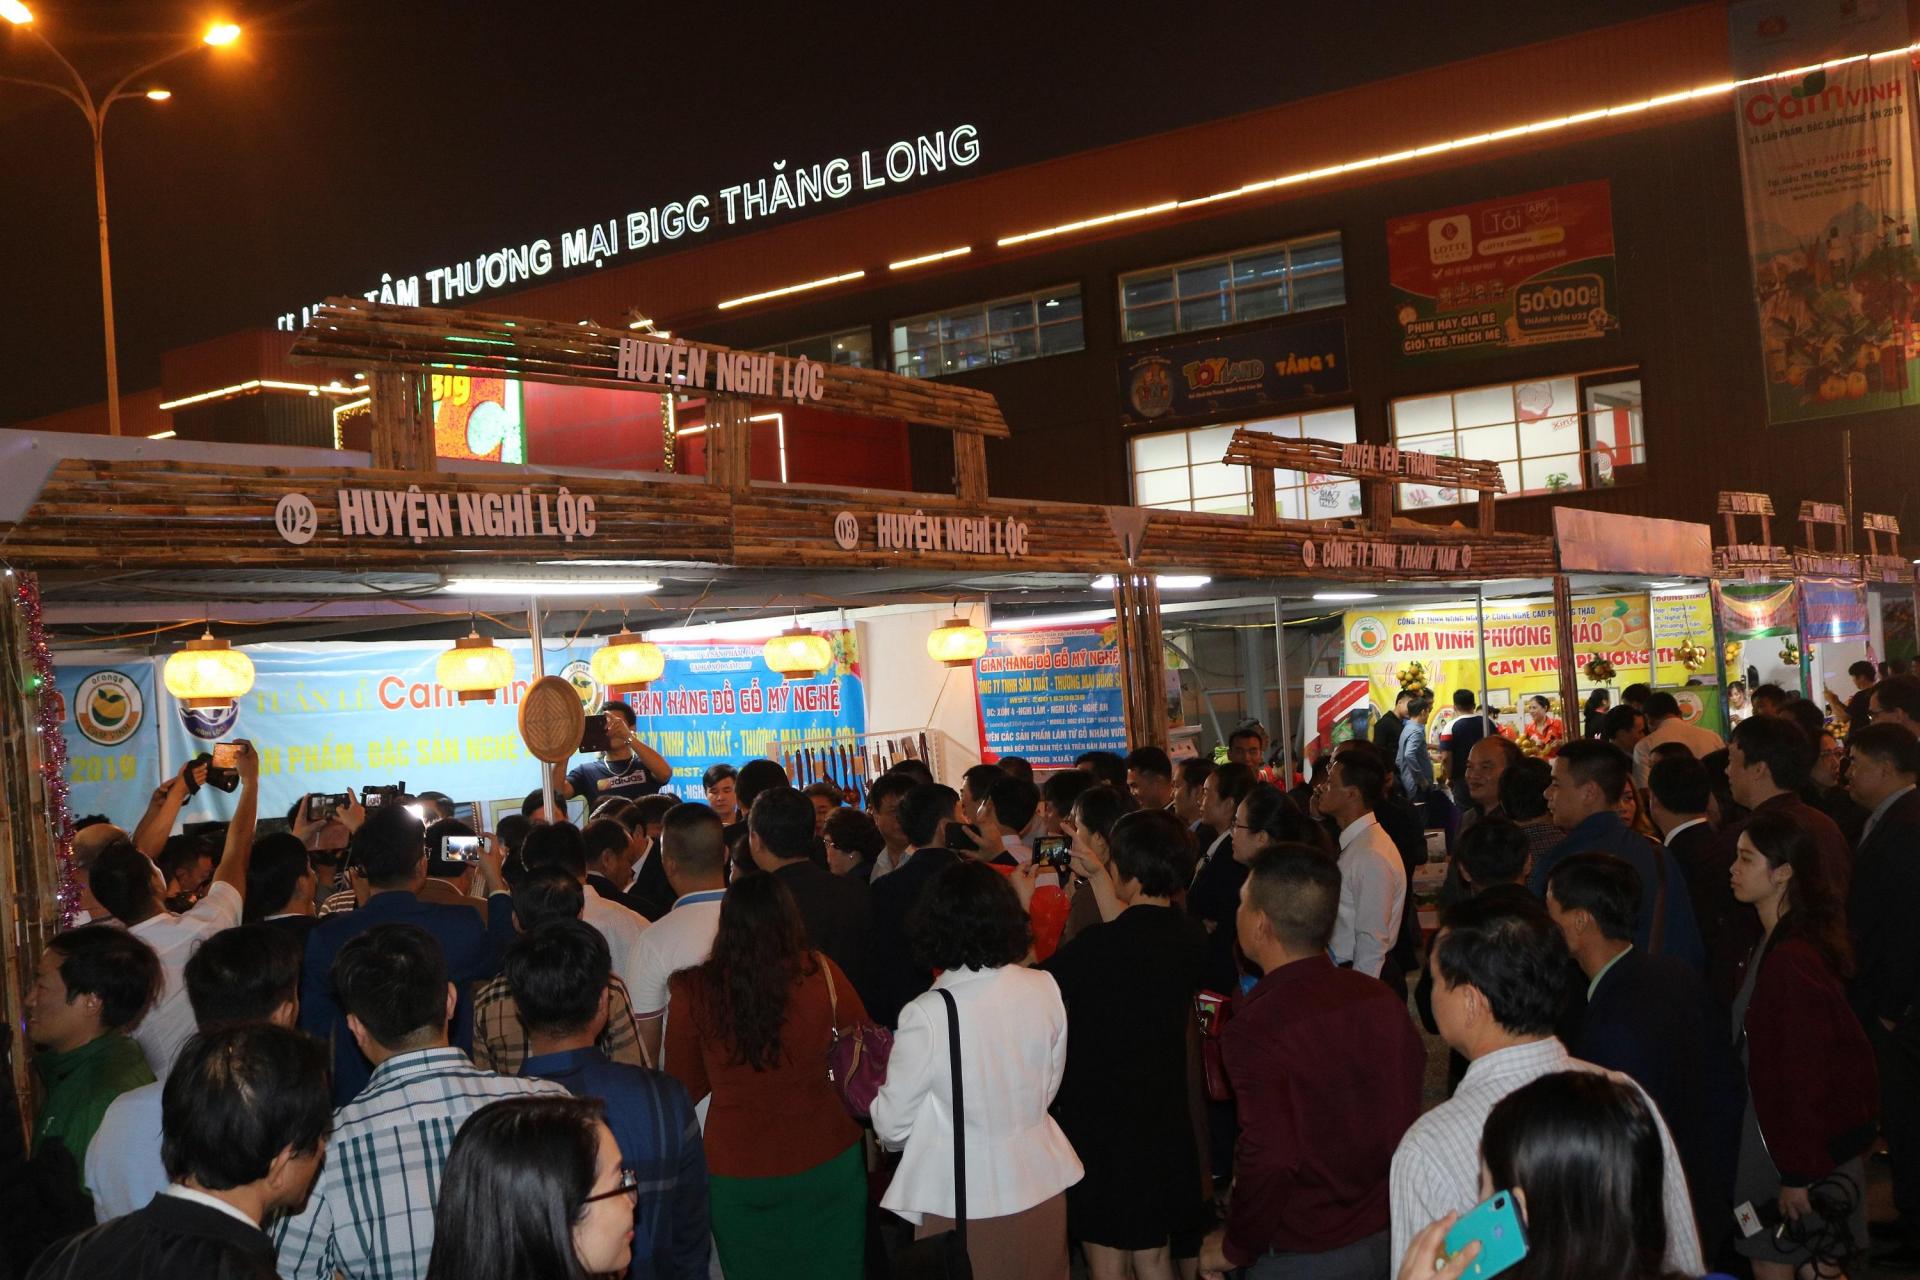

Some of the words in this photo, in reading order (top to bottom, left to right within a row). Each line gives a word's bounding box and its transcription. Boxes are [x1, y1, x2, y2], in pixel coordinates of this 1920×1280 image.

[1745, 83, 1844, 126] Cam
[1847, 80, 1902, 106] VINH
[426, 239, 552, 304] THƯƠNG
[562, 219, 618, 268] MẠI
[627, 194, 709, 250] BIGC
[719, 159, 852, 225] THĂNG
[861, 124, 980, 191] LONG
[1407, 321, 1436, 335] PHIM
[1438, 318, 1458, 331] HAY
[617, 338, 708, 392] HUYỆN
[782, 354, 825, 405] LỘC
[1324, 353, 1336, 369] 1
[338, 484, 454, 544] HUYỆN
[538, 486, 596, 543] LỘC
[877, 509, 941, 555] HUYỆN
[995, 516, 1029, 559] LỘC
[1323, 538, 1353, 568] CÔNG
[1356, 543, 1370, 567] TY
[1371, 543, 1396, 568] TNHH
[1532, 609, 1546, 619] CAO
[1392, 632, 1429, 652] CAM
[1434, 629, 1475, 651] VINH
[980, 657, 1003, 673] GIAN
[1036, 649, 1052, 670] ĐỒ
[1054, 648, 1069, 668] GỖ
[1071, 648, 1087, 667] MỸ
[1488, 656, 1528, 676] CAM
[90, 673, 125, 686] orange
[630, 690, 664, 717] GIAN
[667, 684, 709, 716] HÀNG
[712, 679, 735, 715] ĐỒ
[740, 678, 764, 714] GỖ
[768, 682, 792, 713] MỸ
[794, 680, 841, 717] NGHỆ
[368, 742, 410, 775] ĐẶC
[417, 731, 460, 766] SẢN
[466, 730, 518, 765] NGHỆ
[70, 754, 137, 783] 2019
